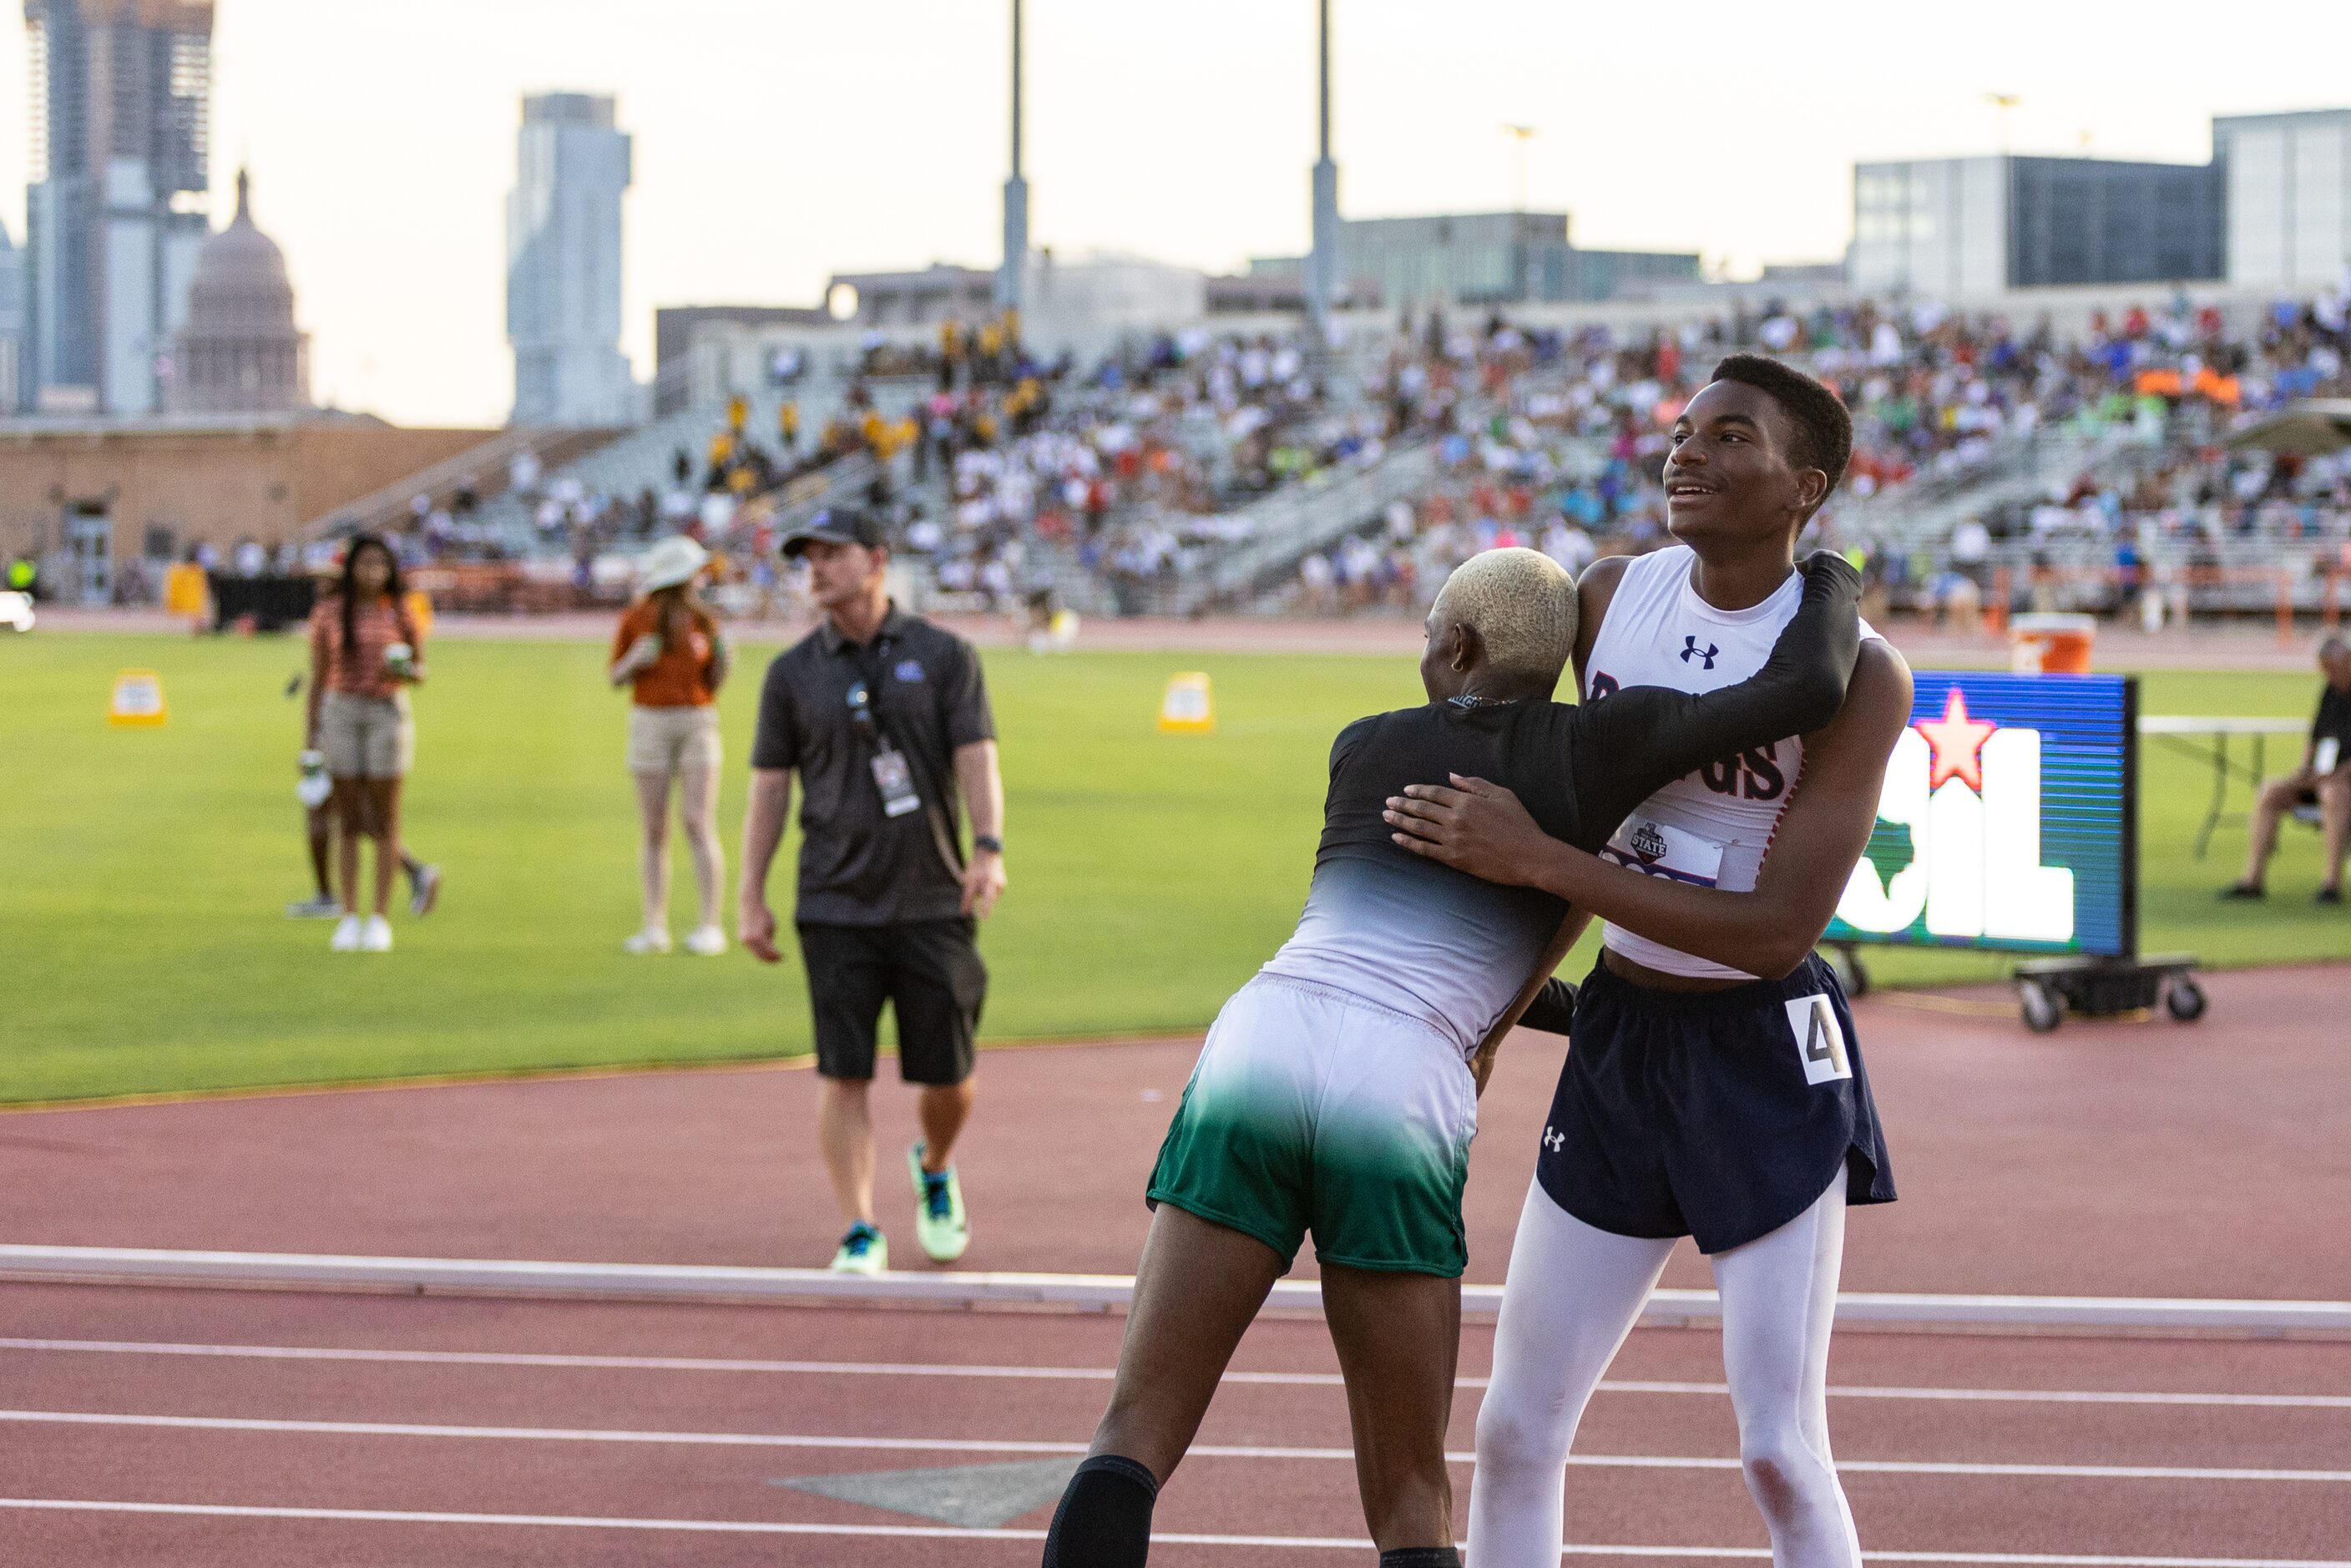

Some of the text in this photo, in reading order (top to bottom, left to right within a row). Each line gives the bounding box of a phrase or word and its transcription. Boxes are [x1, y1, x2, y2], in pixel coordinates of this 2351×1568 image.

[1631, 834, 1666, 855] STATE
[1833, 690, 2074, 942] UIL
[1806, 1000, 1842, 1074] 4
